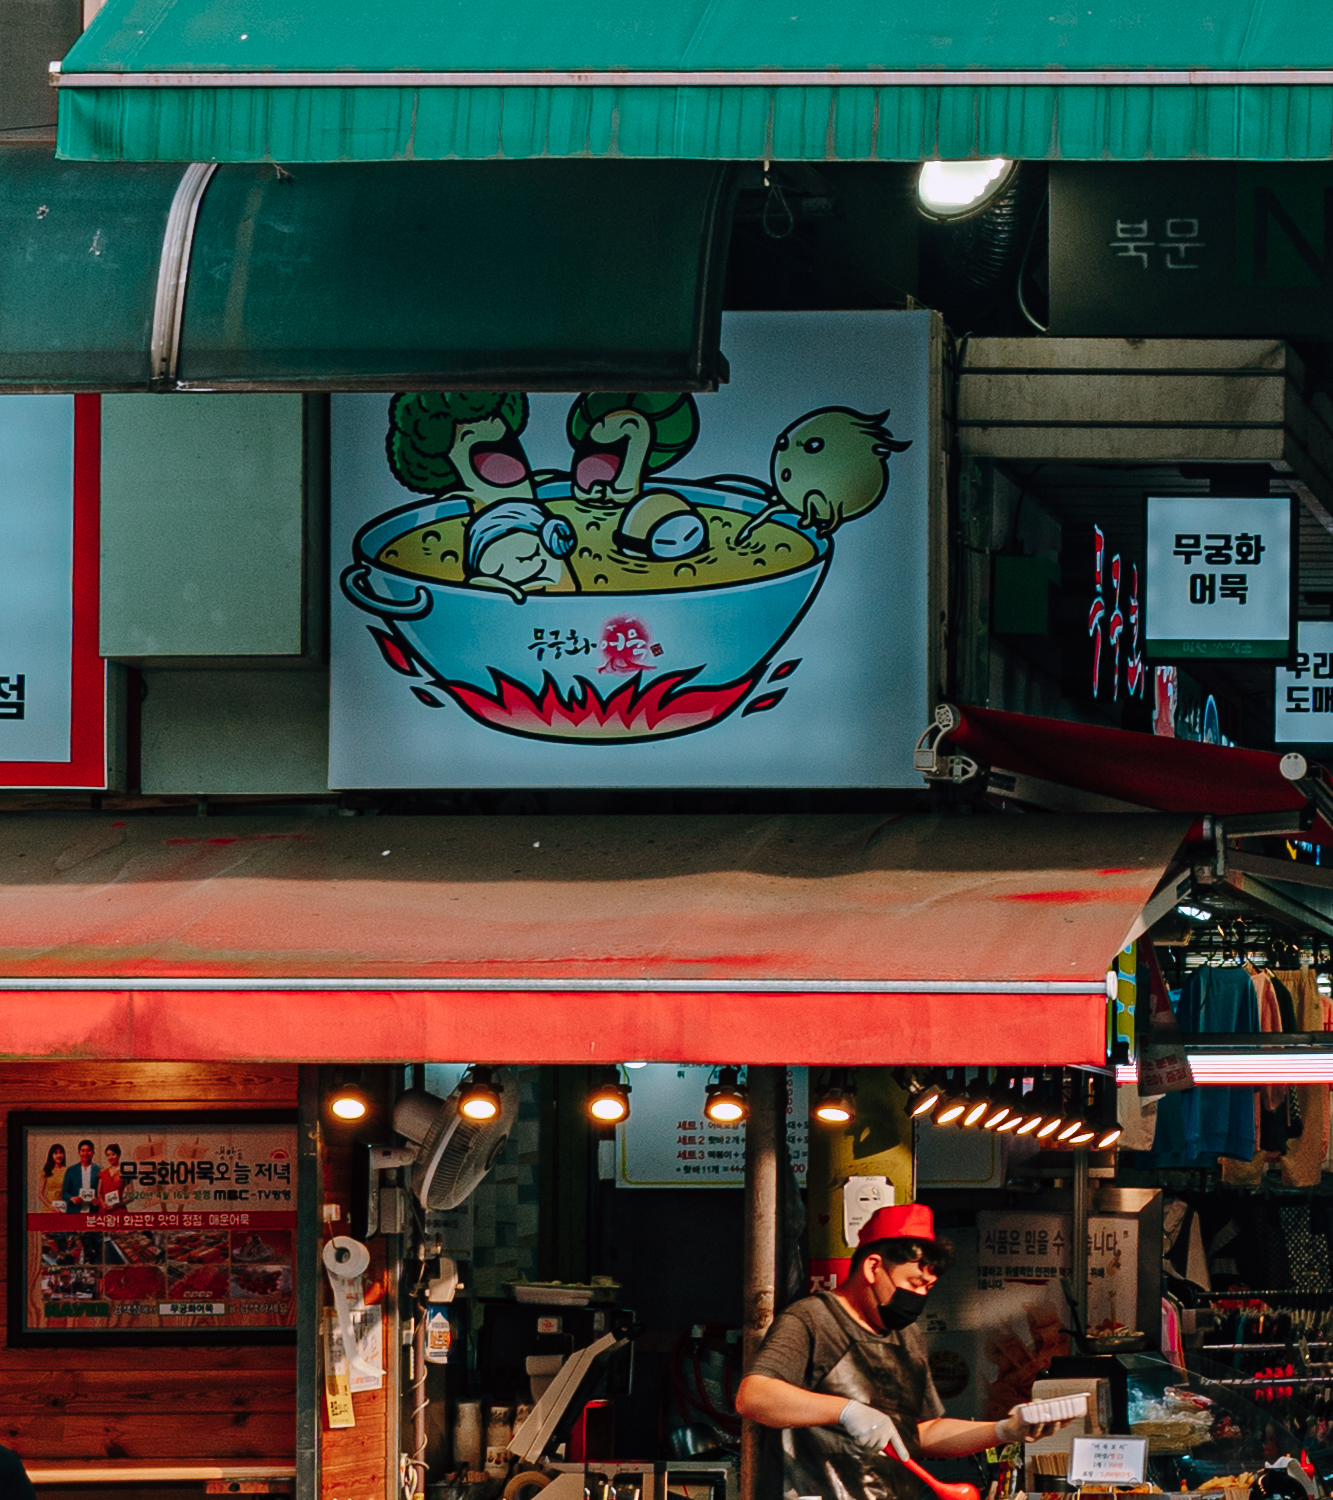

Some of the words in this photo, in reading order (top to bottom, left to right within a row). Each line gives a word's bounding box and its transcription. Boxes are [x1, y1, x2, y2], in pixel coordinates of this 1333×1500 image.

[1109, 217, 1206, 270] 북문
[1172, 532, 1266, 566] 무궁화
[1189, 572, 1249, 605] 어묵
